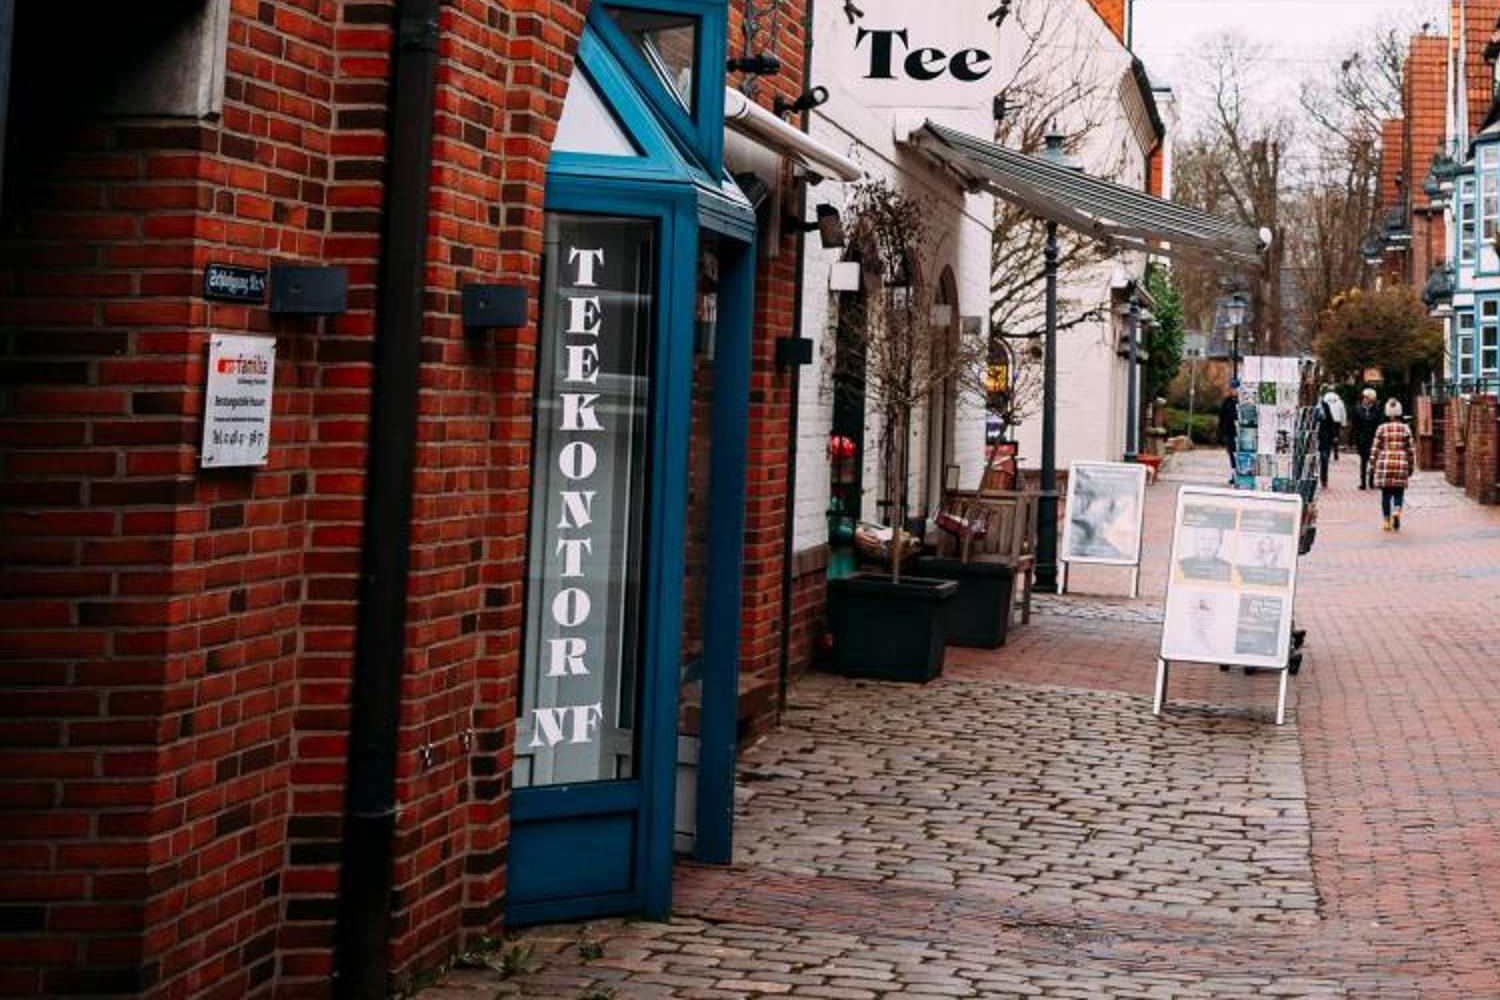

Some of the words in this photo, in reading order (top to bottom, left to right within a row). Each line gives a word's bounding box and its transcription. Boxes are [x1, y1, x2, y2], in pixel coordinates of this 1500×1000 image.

[855, 27, 982, 81] Tee
[546, 247, 605, 677] TEEKONTOR
[528, 702, 603, 748] NF
